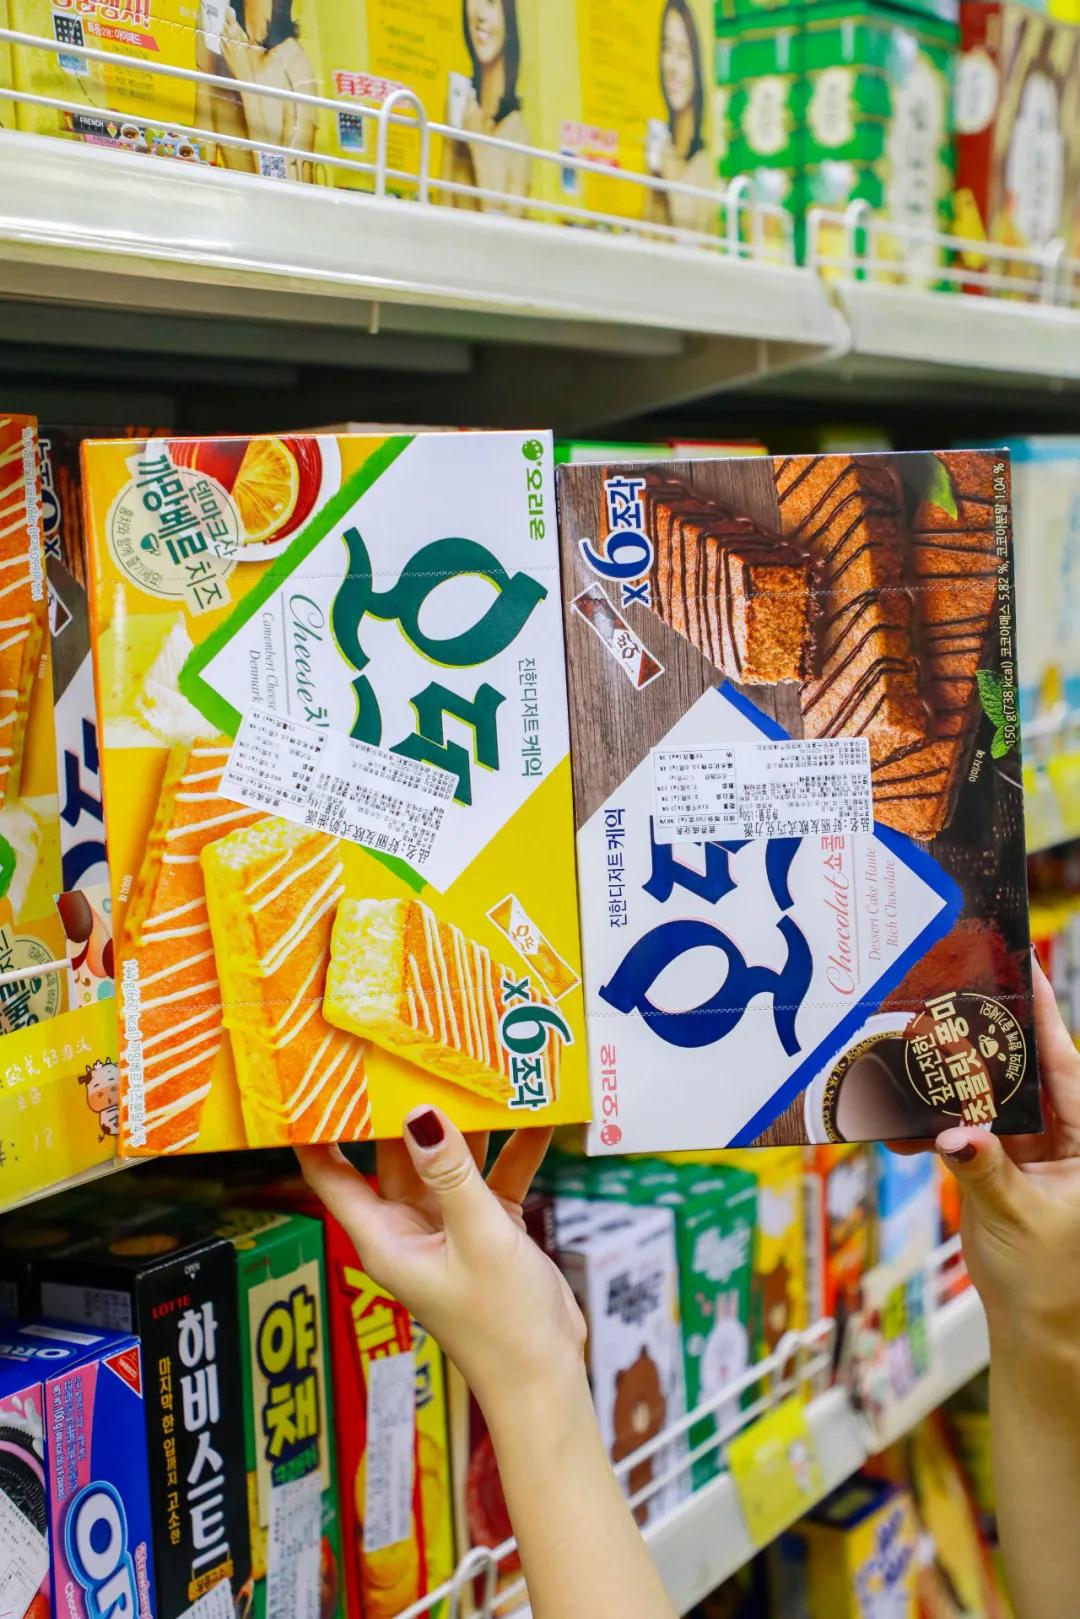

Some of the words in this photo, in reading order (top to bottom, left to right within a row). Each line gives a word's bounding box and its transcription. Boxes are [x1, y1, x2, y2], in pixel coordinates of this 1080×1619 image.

[80, 117, 104, 128] FRENCH
[526, 468, 545, 541] 오리온
[994, 477, 1006, 499] 1.04
[137, 455, 208, 565] 까망베르
[185, 561, 223, 610] 치즈
[189, 479, 238, 559] 덴마크산
[995, 504, 1008, 557] 코코아분말
[998, 578, 1010, 600] 5.82
[262, 612, 275, 671] Camembert
[289, 594, 325, 703] Cheese
[999, 604, 1012, 657] 코코아매스
[249, 649, 261, 703] Denmark
[266, 674, 277, 711] Cheese
[1002, 661, 1014, 688] kcal)
[1004, 724, 1016, 745] 150
[865, 886, 879, 914] Cake
[884, 859, 897, 918] Chocolate
[823, 869, 855, 996] Chocolat
[867, 918, 882, 960] Dessert
[886, 921, 899, 947] Rich
[925, 991, 970, 1045] 풍미
[1005, 1031, 1022, 1050] 함께
[600, 1044, 618, 1117] 오리온
[945, 1048, 998, 1122] 초콜릿
[1005, 1053, 1023, 1082] 커피와
[151, 1295, 191, 1319] LOTTE
[158, 1356, 173, 1411] 마지막
[259, 1291, 318, 1458] 야채
[161, 1413, 175, 1434] 한
[177, 1300, 230, 1571] 하비스트
